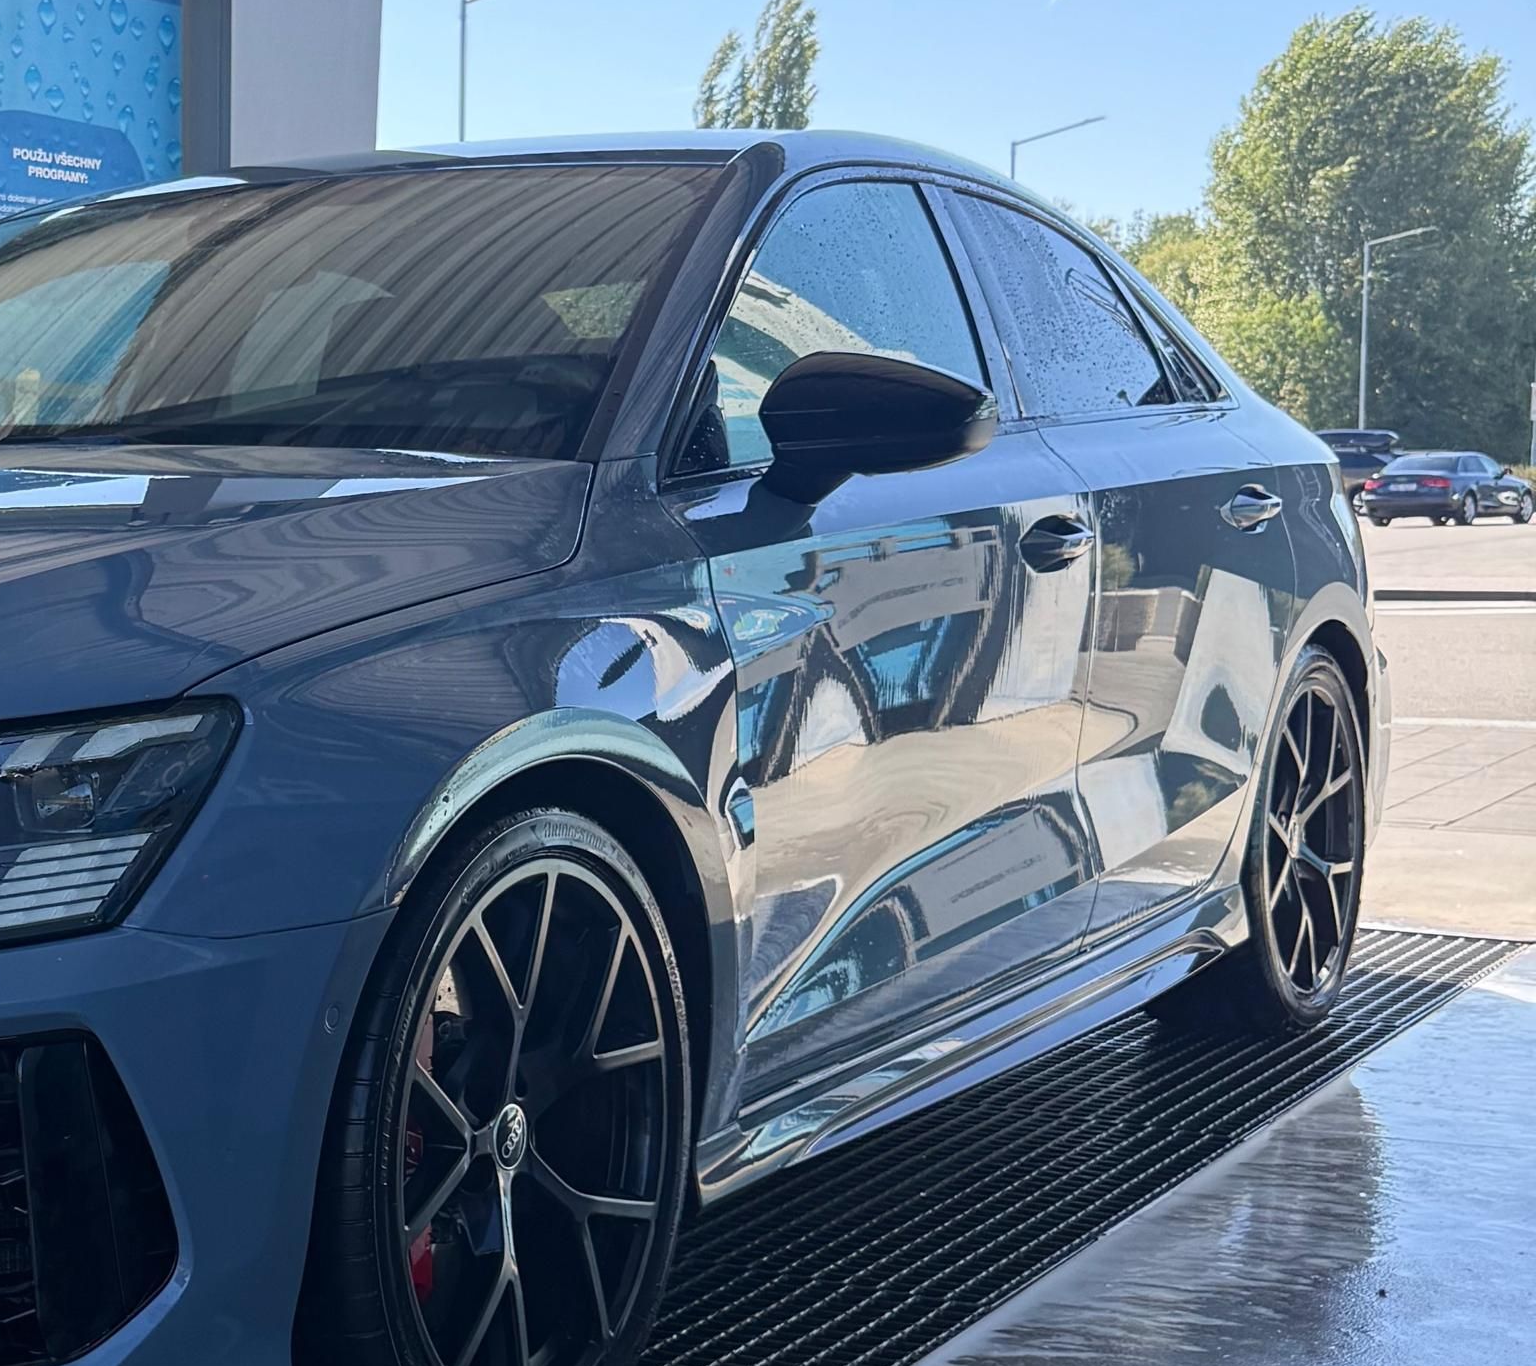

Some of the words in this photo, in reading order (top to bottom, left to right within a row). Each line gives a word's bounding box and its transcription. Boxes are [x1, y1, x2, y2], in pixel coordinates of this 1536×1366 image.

[13, 147, 52, 164] POUŽIJ
[54, 152, 102, 170] VŠECHNY
[28, 165, 88, 184] PROGRAMY:
